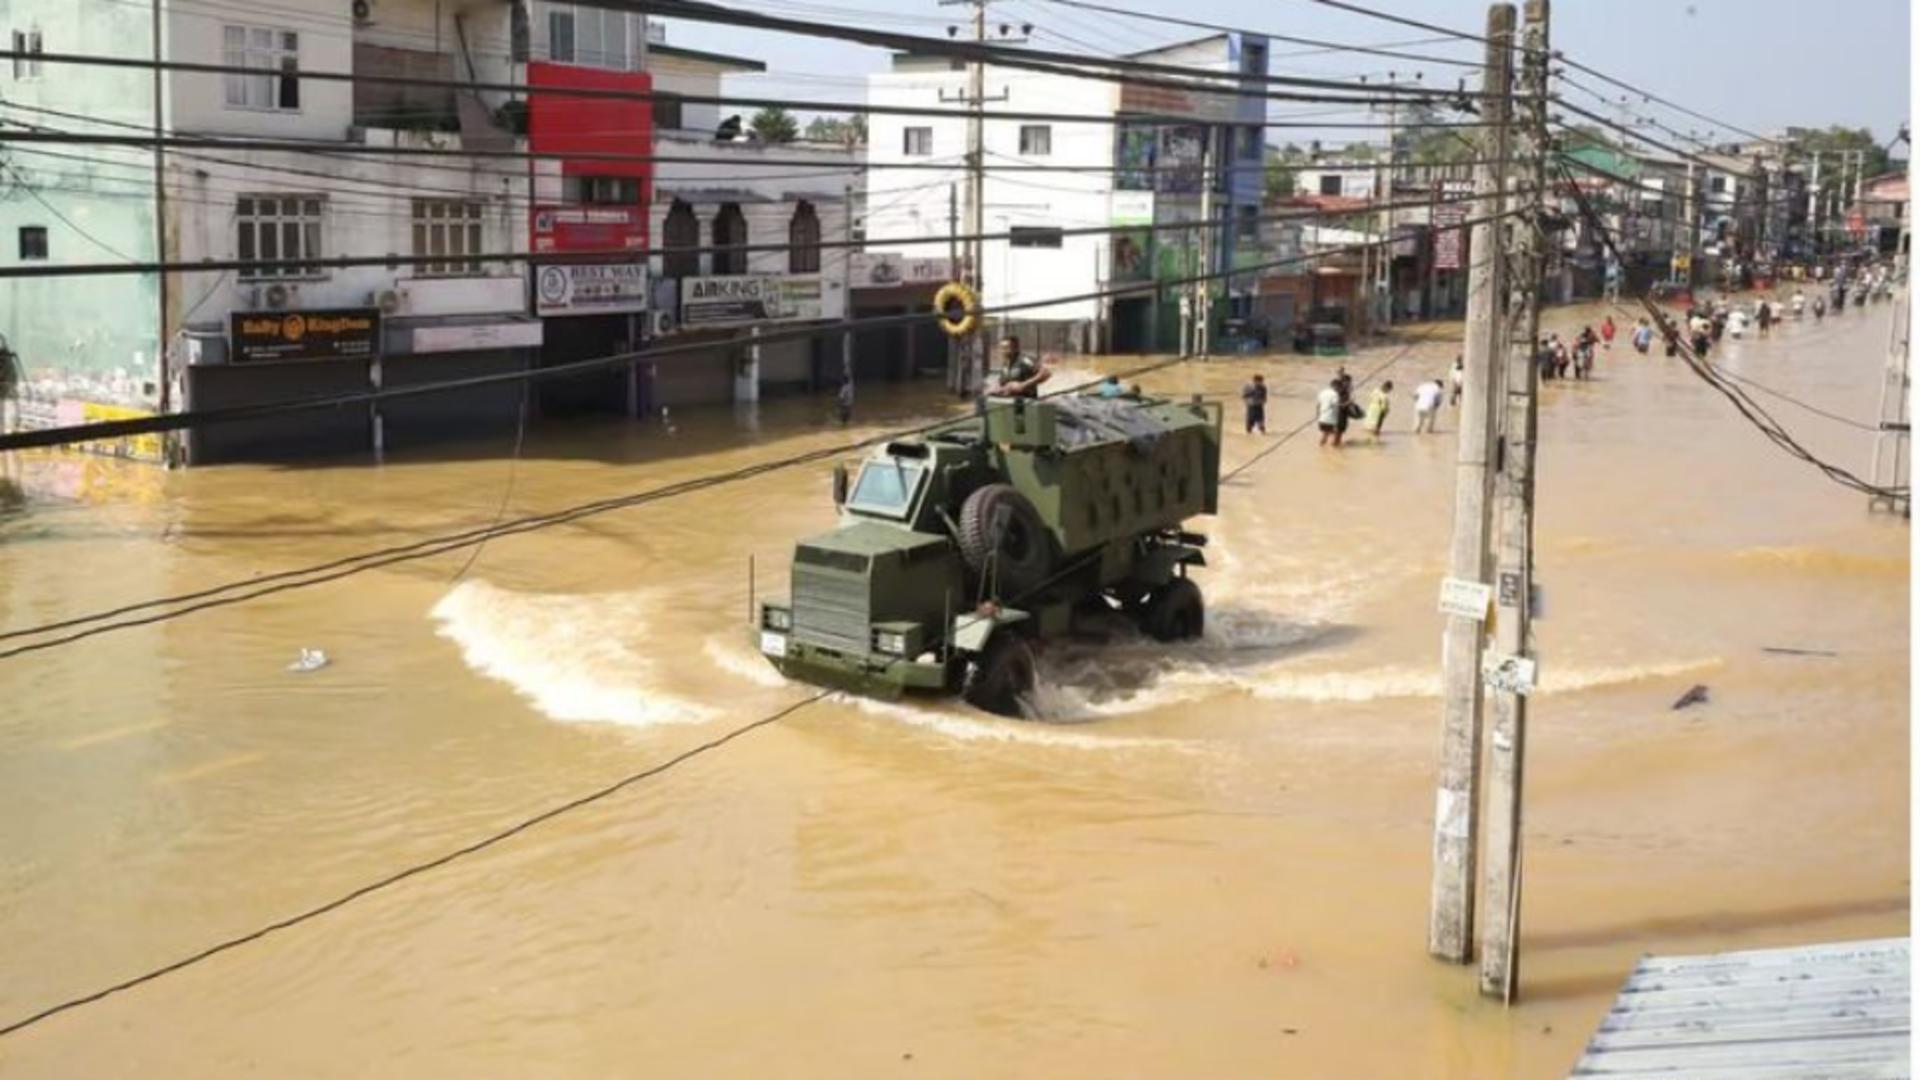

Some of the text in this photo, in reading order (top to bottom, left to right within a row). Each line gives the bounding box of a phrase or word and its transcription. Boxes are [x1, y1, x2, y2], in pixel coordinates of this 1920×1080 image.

[570, 265, 642, 280] BEST WAY
[693, 280, 759, 298] AIRKING
